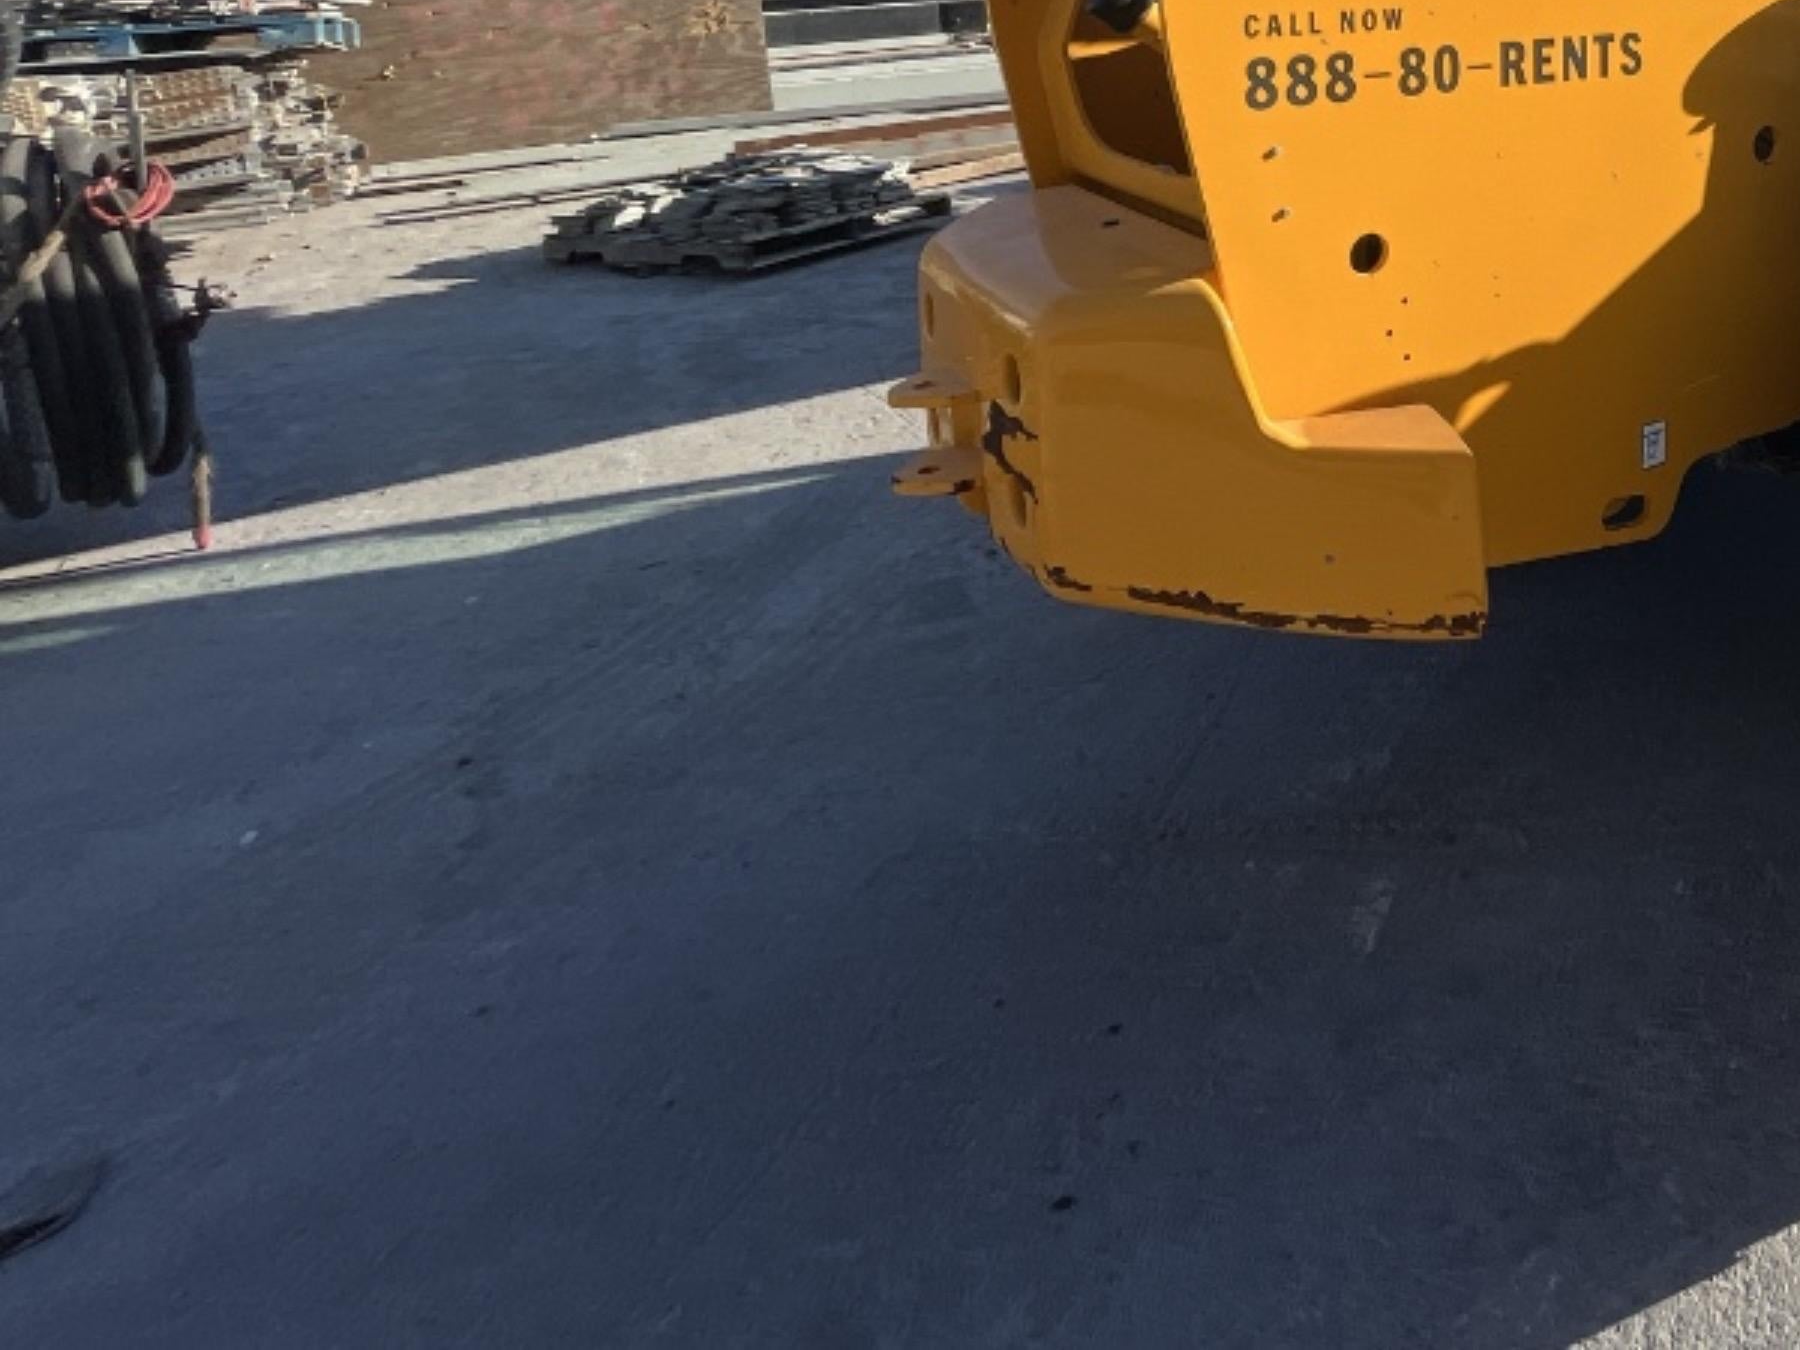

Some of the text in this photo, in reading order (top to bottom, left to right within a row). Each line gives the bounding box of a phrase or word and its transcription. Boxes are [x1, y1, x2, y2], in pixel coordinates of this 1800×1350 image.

[1243, 8, 1404, 38] CALL NOW
[1243, 32, 1644, 111] 888-80-RENTS
